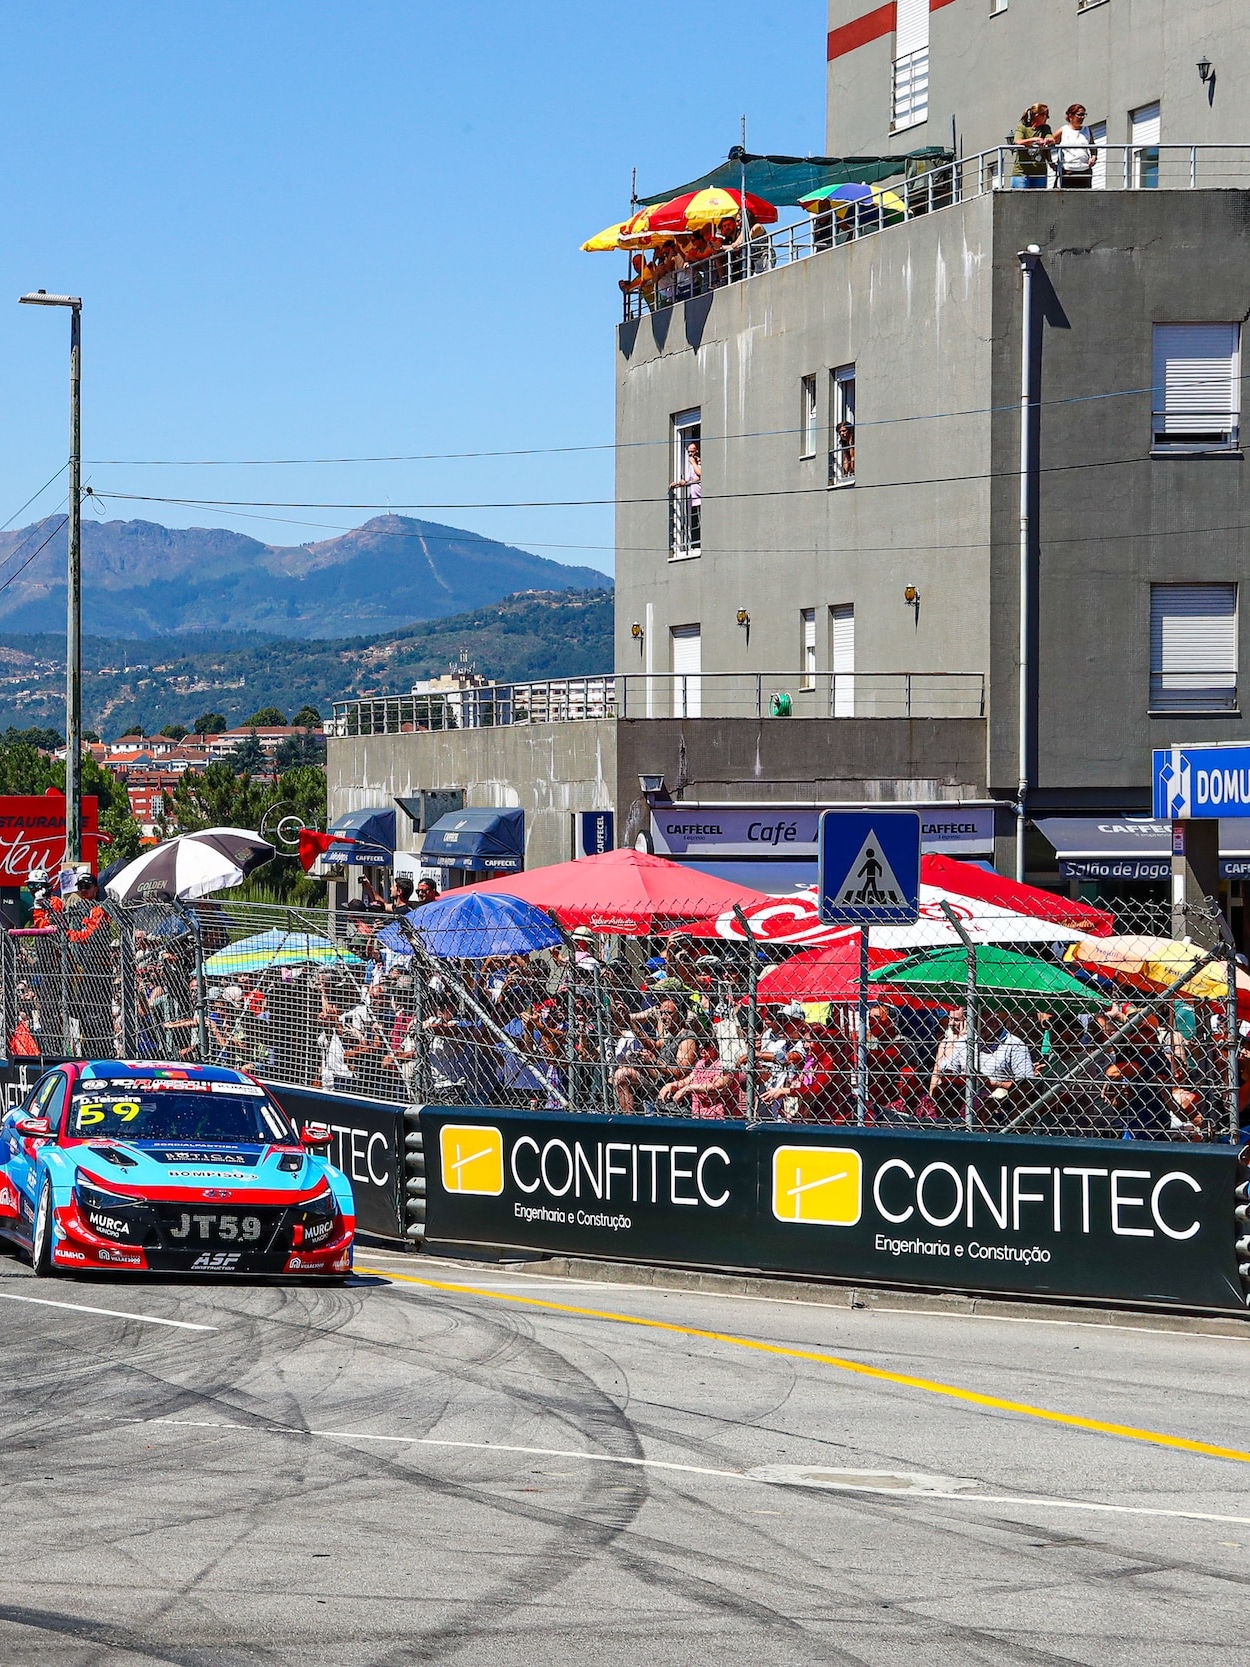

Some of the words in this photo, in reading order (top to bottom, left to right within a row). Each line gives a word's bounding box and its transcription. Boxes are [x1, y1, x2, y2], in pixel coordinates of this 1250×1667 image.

[747, 822, 797, 846] Café
[1112, 861, 1131, 876] de
[137, 880, 168, 893] GOLDEN
[81, 1103, 141, 1125] 59
[511, 1136, 731, 1208] CONFITEC
[873, 1158, 1203, 1241] CONFITEC
[170, 1213, 262, 1241] JT59
[514, 1202, 566, 1225] Engenharia
[567, 1213, 576, 1225] e
[577, 1209, 631, 1231] Construção
[55, 1249, 86, 1260] KUMHO
[194, 1253, 242, 1266] ASF
[875, 1233, 950, 1258] Engenharia
[954, 1244, 964, 1258] e
[967, 1241, 1051, 1266] Construção
